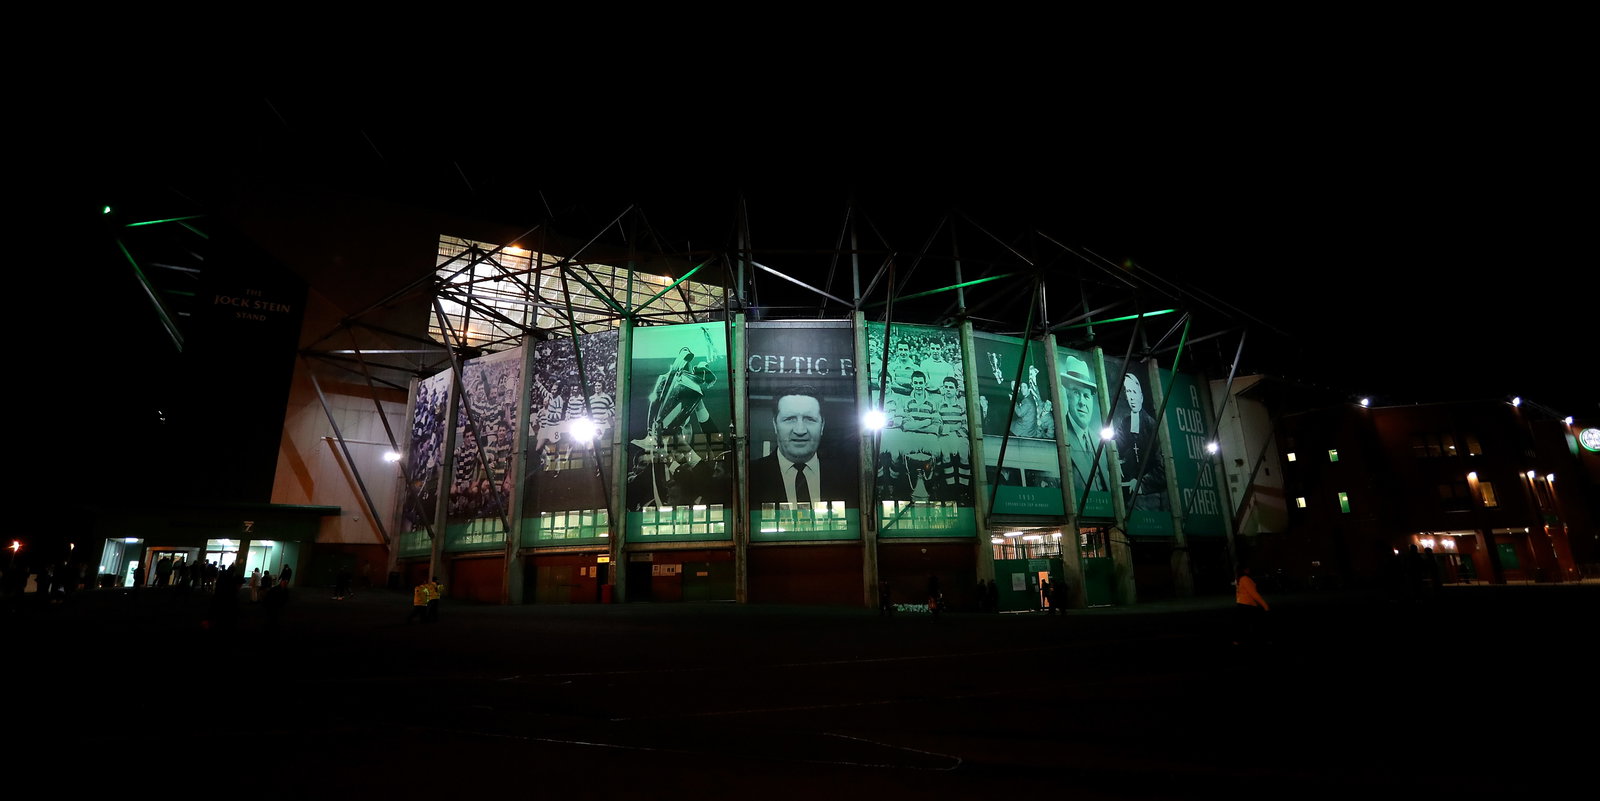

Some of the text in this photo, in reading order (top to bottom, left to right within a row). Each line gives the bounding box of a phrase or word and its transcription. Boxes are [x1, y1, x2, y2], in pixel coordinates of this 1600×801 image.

[214, 295, 291, 313] JOCK STEIN
[235, 311, 267, 321] STAND
[748, 354, 829, 376] CELTIC
[1190, 384, 1199, 408] A
[1176, 407, 1204, 434] CLUB
